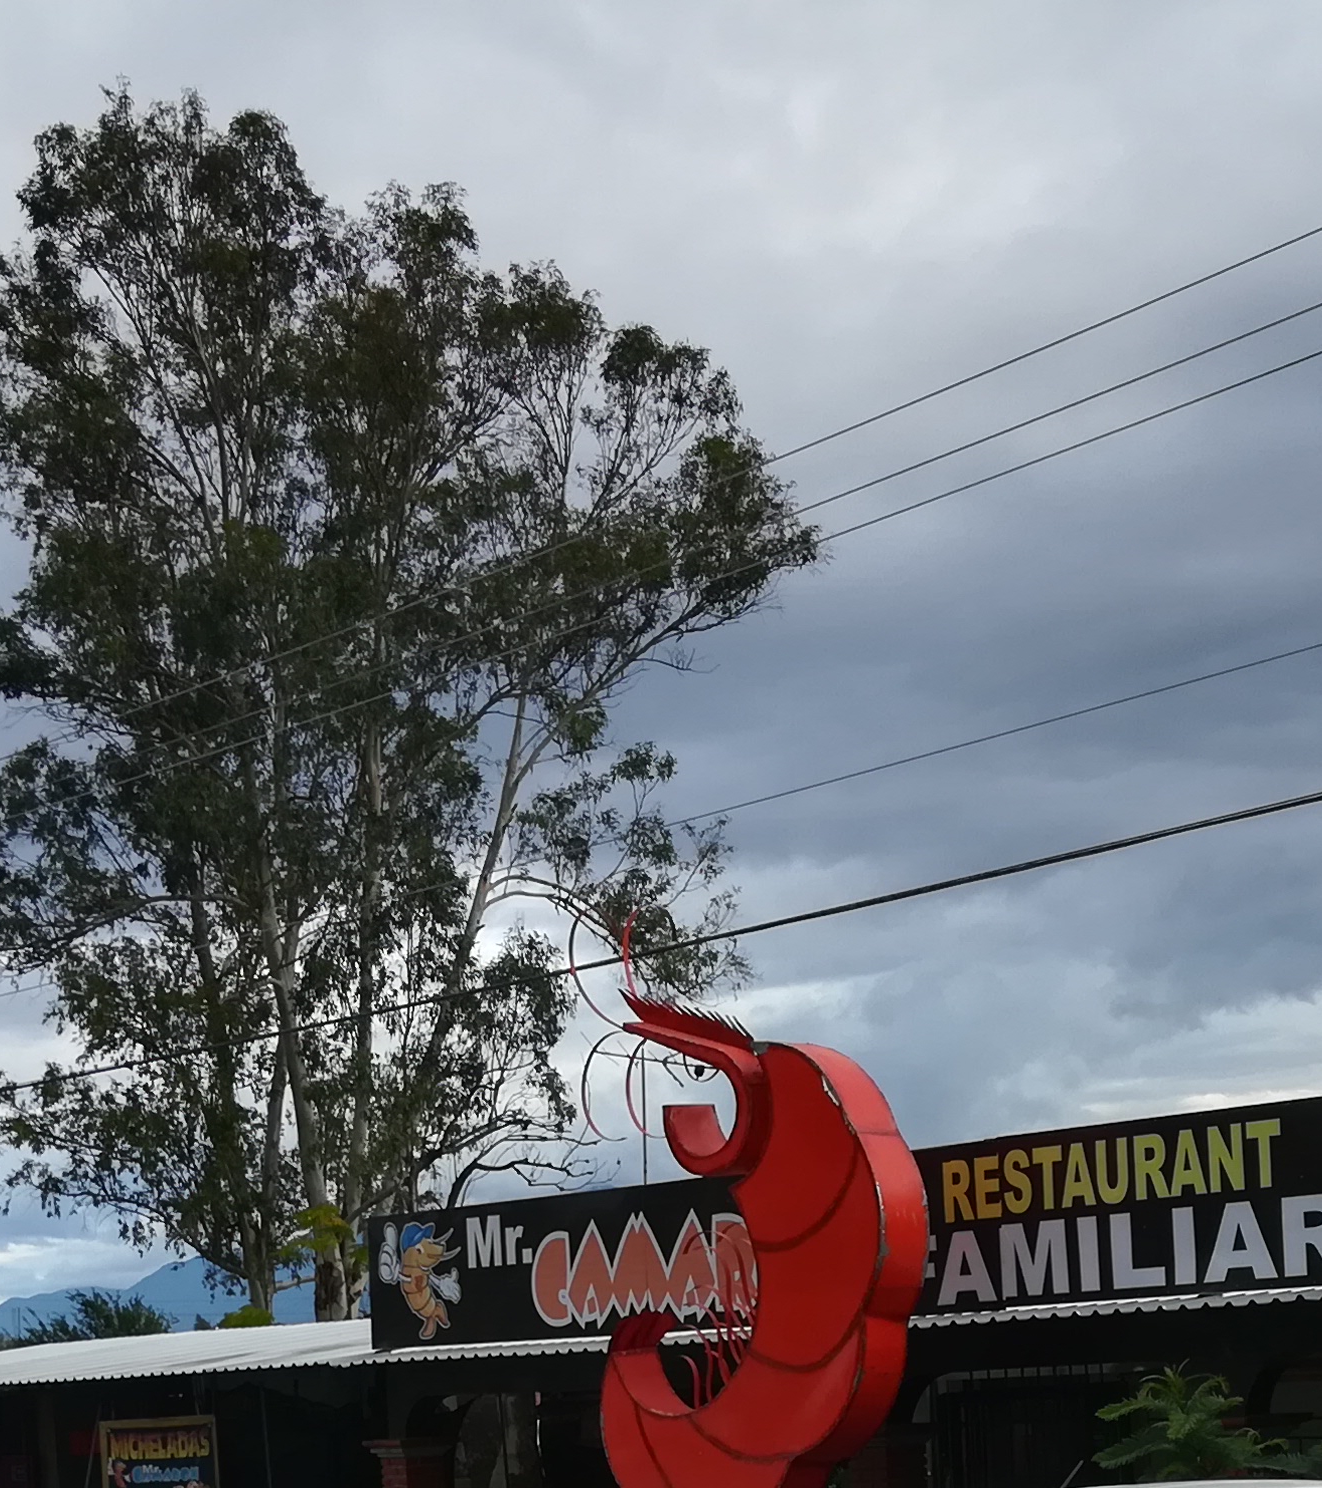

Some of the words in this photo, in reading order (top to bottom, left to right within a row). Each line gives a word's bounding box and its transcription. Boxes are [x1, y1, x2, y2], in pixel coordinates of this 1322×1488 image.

[943, 1118, 1280, 1223] RESTAURANT
[465, 1215, 532, 1269] Mr.
[532, 1208, 758, 1328] CAMAR
[110, 1430, 210, 1460] MICHELADAS
